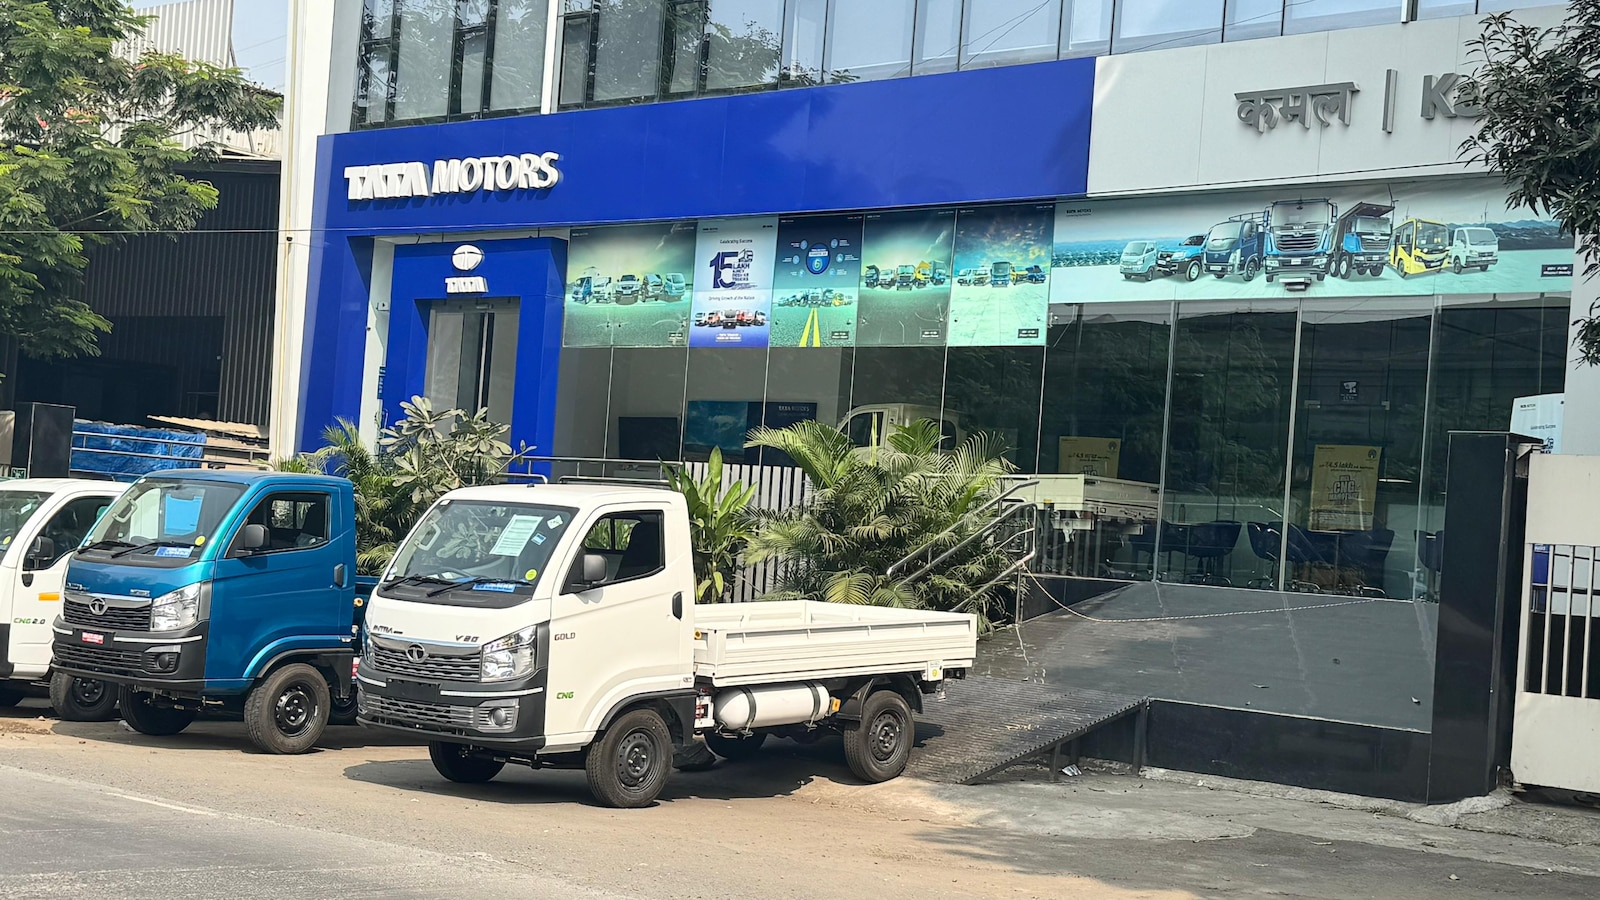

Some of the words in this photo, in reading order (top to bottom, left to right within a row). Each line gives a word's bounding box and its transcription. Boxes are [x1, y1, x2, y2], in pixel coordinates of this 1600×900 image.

[1234, 81, 1360, 133] कमल
[344, 161, 430, 201] TATA
[430, 151, 561, 195] MOTORS
[709, 251, 739, 290] 15
[732, 262, 750, 270] LAKH
[444, 276, 489, 293] TATA
[1333, 480, 1356, 494] CNG
[372, 624, 393, 635] INTRA
[554, 632, 576, 641] GOLD
[556, 691, 575, 700] CNG
